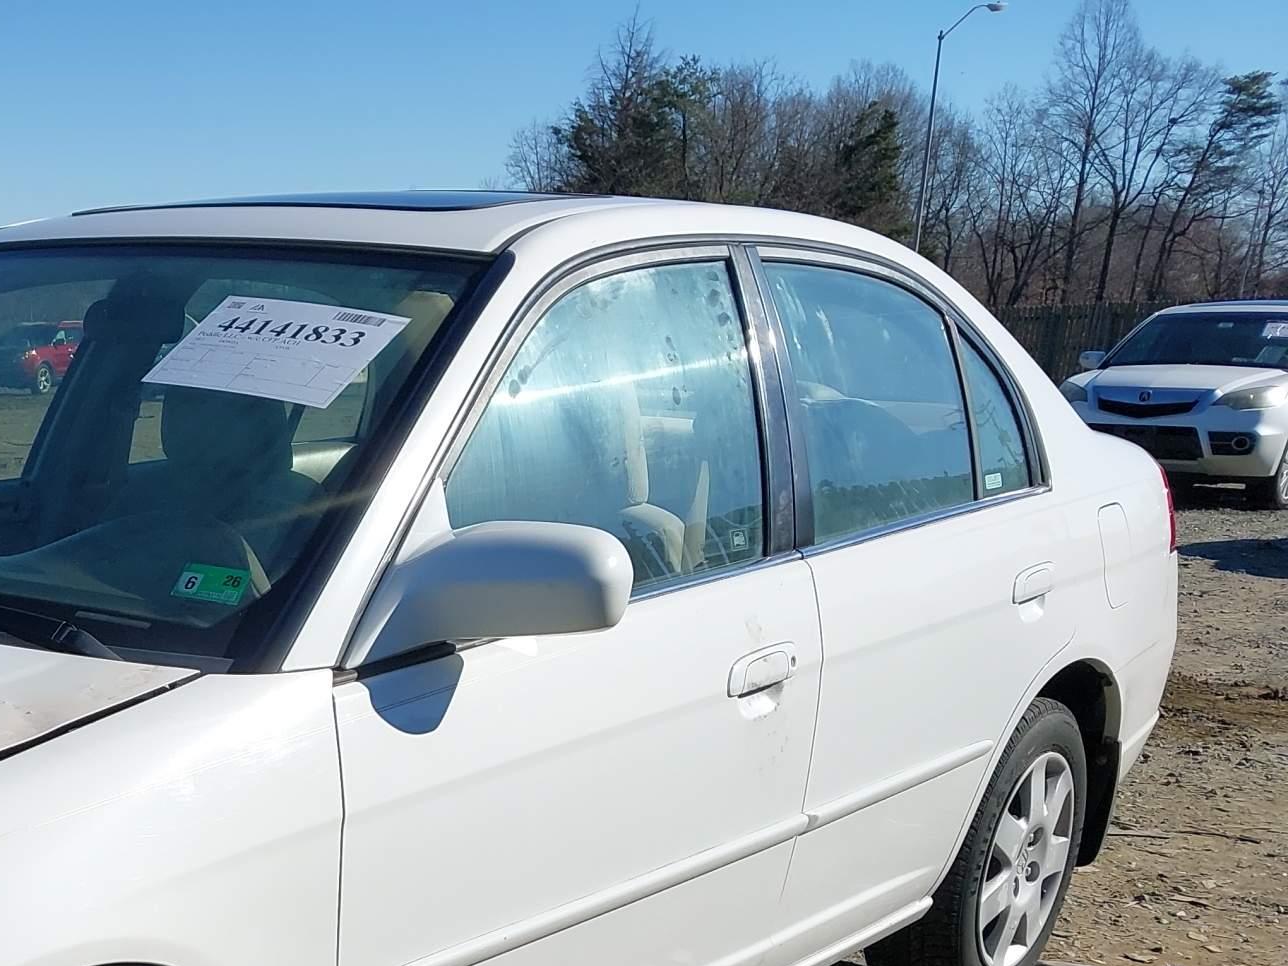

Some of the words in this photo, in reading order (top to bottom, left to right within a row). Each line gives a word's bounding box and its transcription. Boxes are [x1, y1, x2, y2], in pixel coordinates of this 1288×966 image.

[218, 316, 367, 348] 44141833
[184, 576, 198, 590] 6
[223, 575, 242, 588] 26
